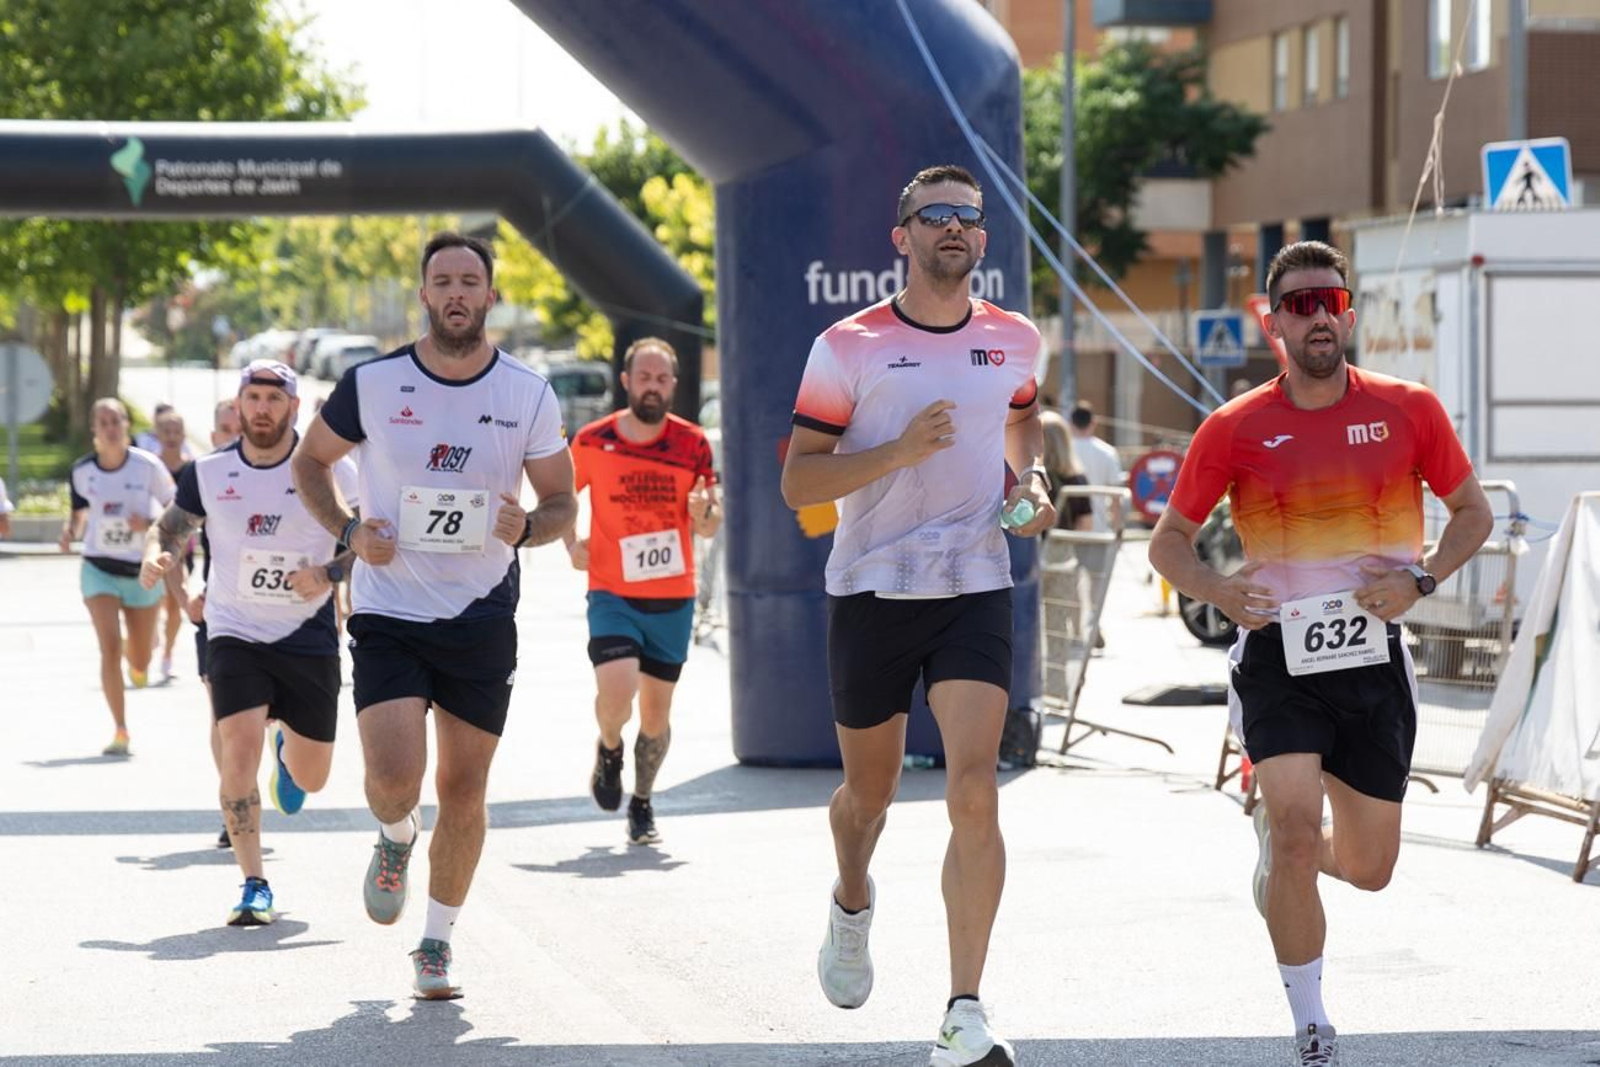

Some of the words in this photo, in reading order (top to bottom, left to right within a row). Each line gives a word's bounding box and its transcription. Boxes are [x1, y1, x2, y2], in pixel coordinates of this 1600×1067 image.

[156, 159, 234, 178] Patronato
[237, 158, 316, 178] Municipal
[318, 158, 341, 177] de
[156, 177, 231, 197] Deportes
[233, 178, 256, 196] de
[805, 259, 1004, 304] fundón
[389, 416, 423, 426] Santander
[426, 509, 463, 535] 78
[636, 546, 671, 568] 100
[1304, 615, 1368, 653] 632
